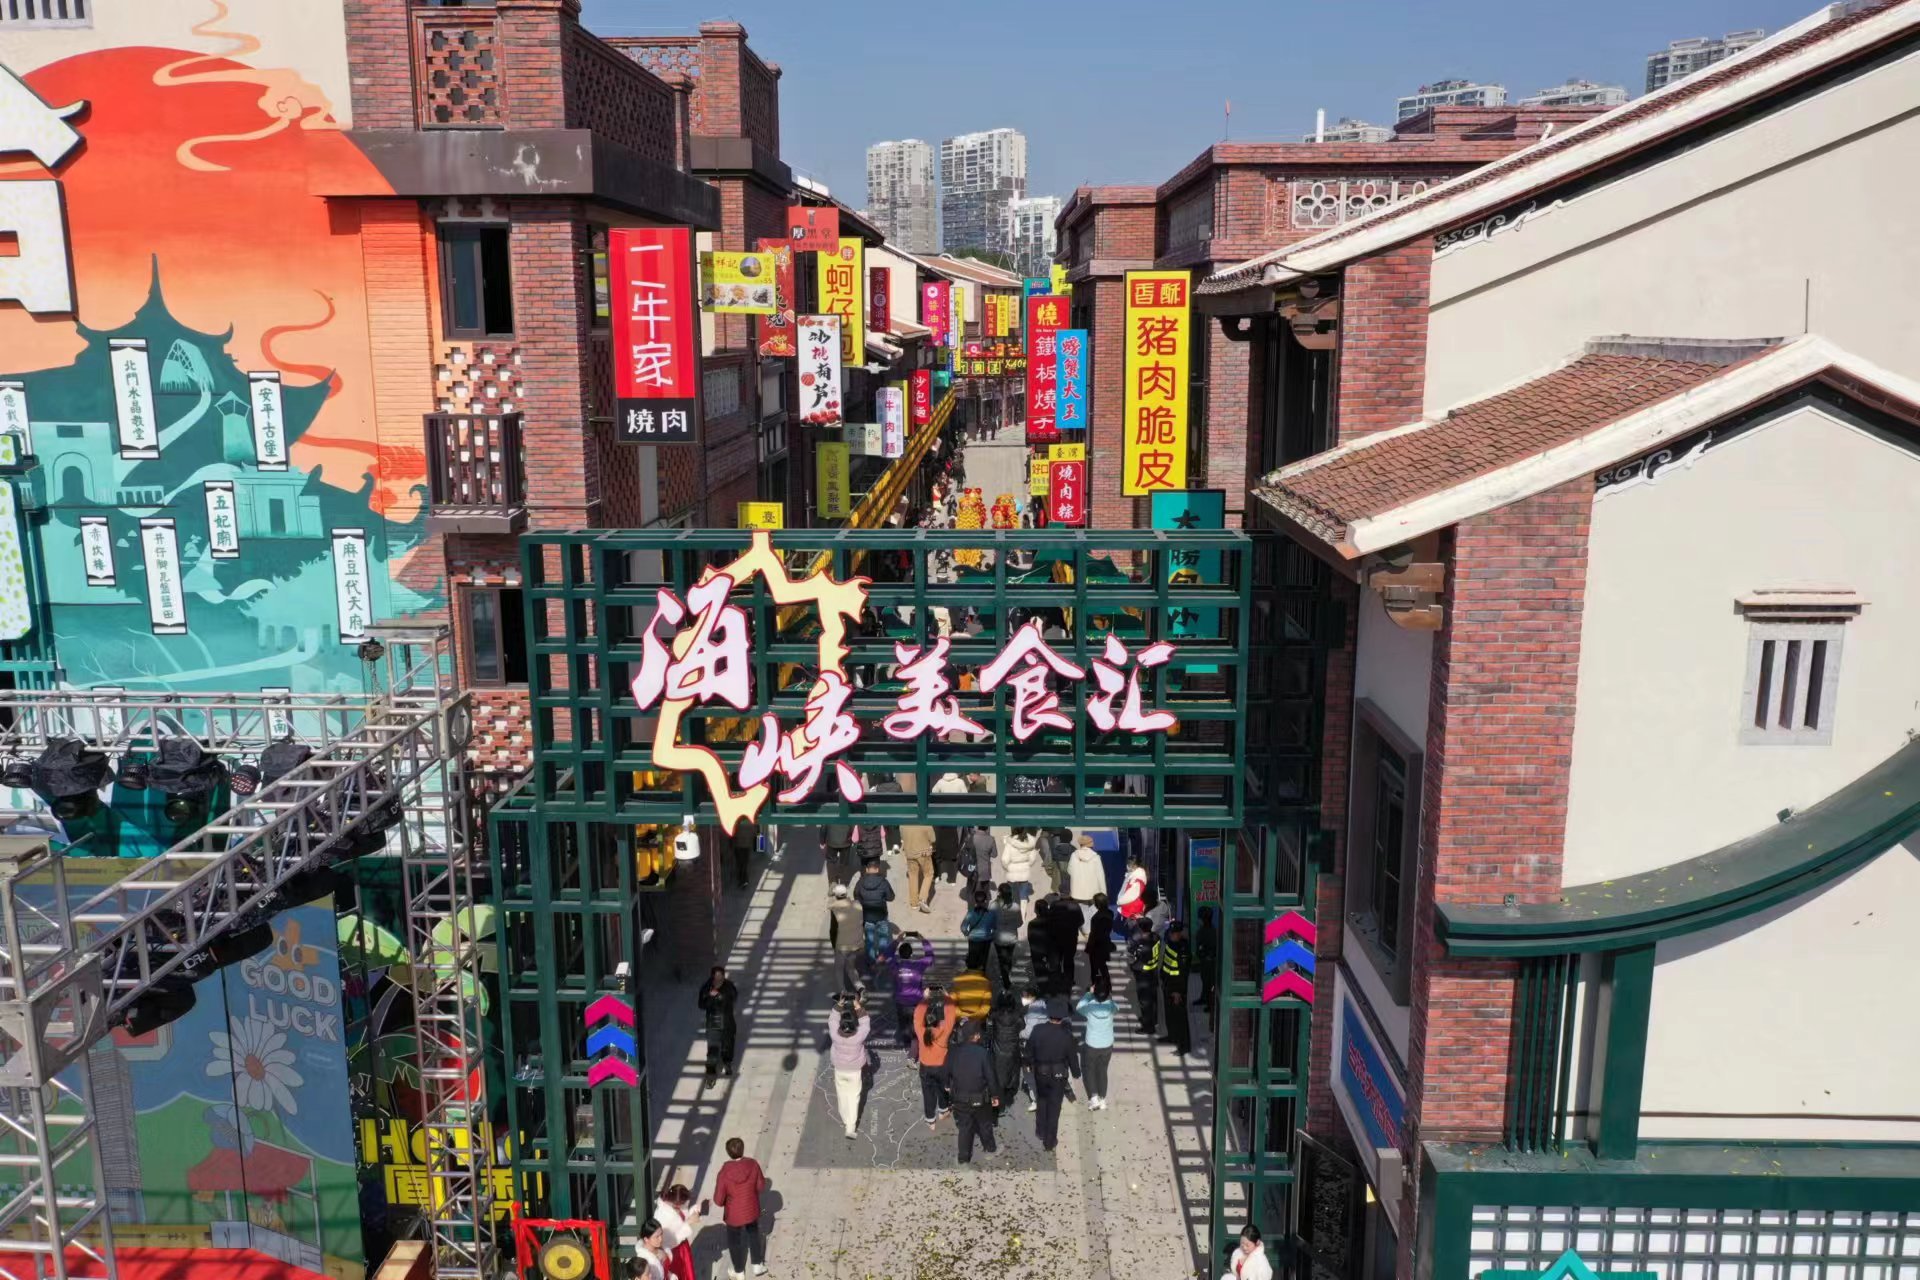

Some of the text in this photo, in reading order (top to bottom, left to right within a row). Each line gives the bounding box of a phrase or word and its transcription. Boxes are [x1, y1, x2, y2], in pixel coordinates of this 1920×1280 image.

[1061, 337, 1081, 421] 螃蟹大王
[1135, 315, 1178, 489] 豬肉脆皮
[258, 387, 279, 457] 安平古堡
[213, 495, 232, 547] 五妃廟
[343, 542, 363, 630] 麻豆代天府
[240, 955, 337, 1007] GOOD
[248, 992, 341, 1042] LUCK
